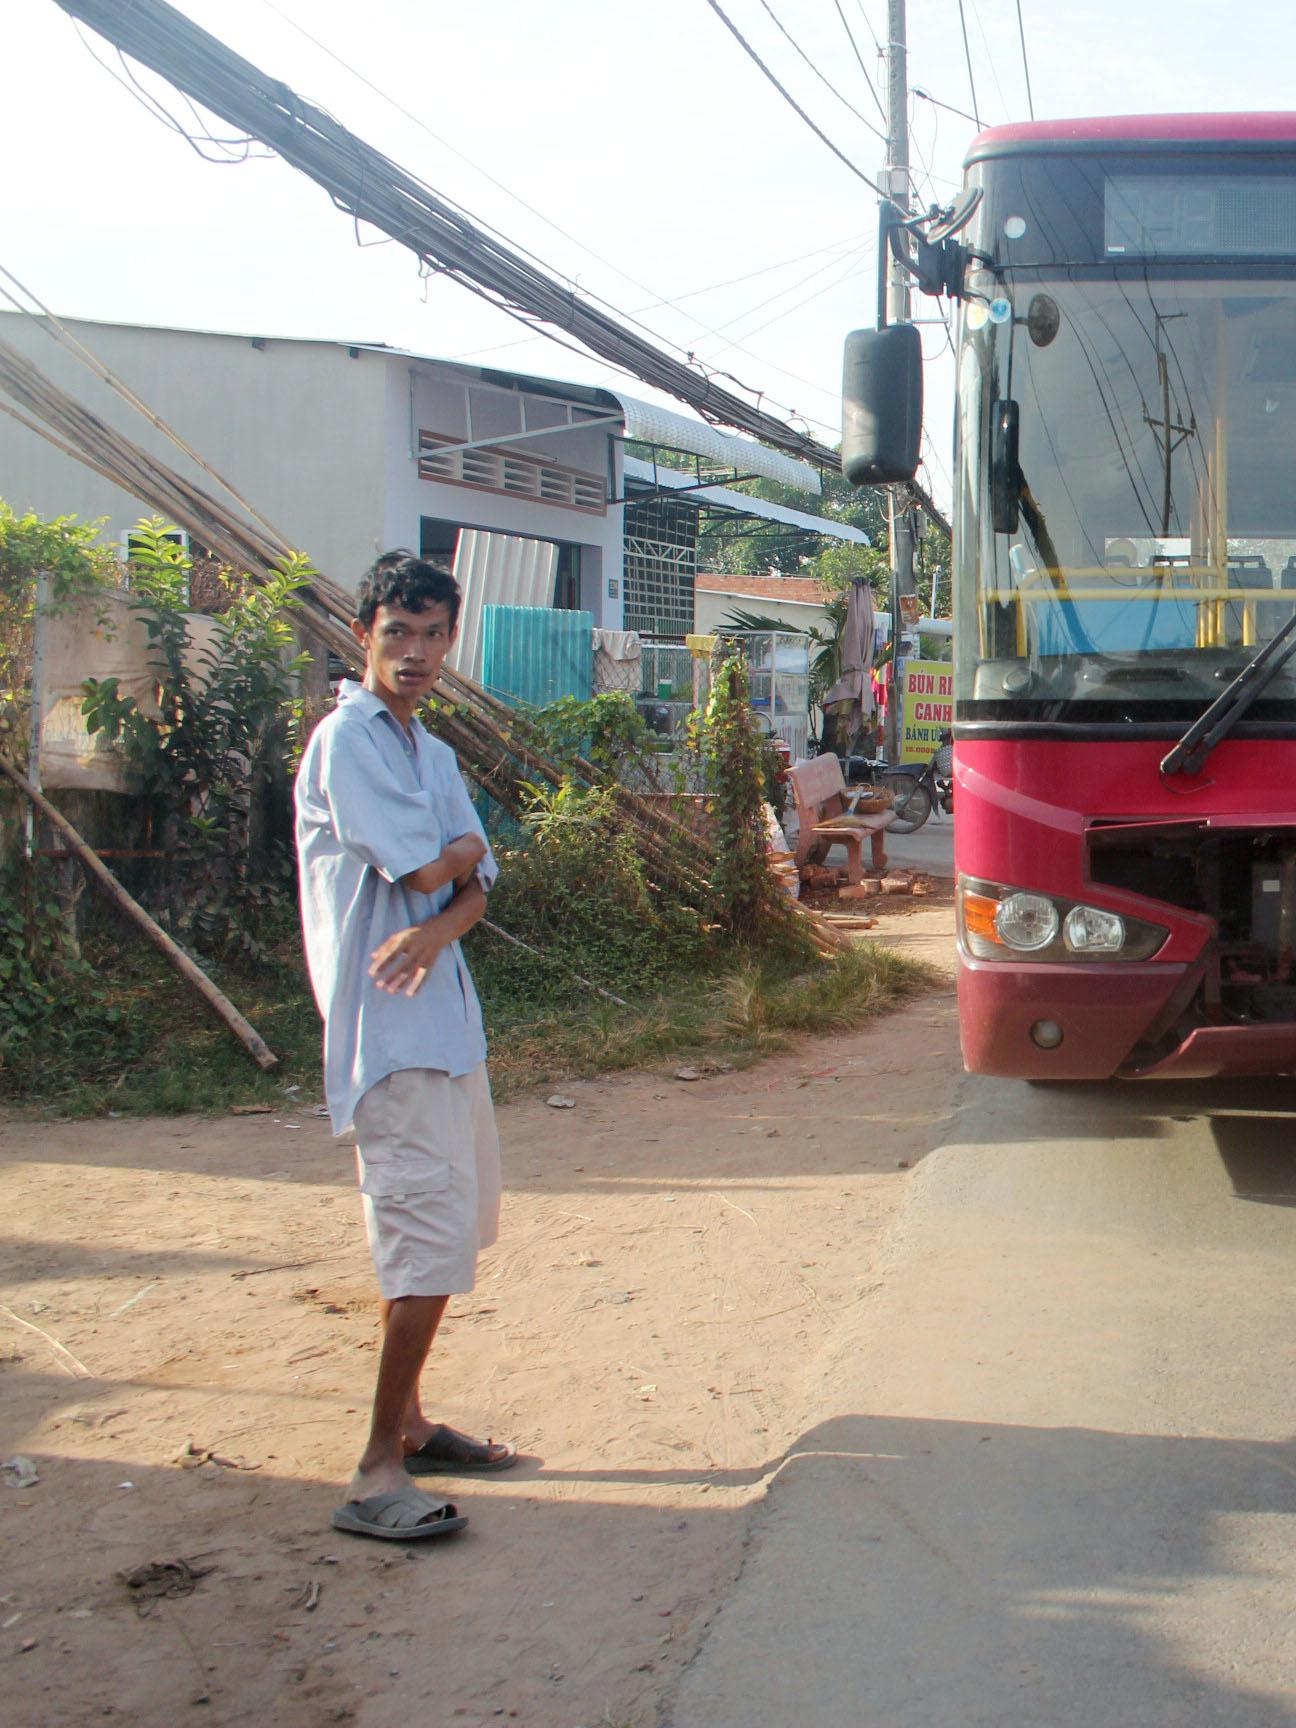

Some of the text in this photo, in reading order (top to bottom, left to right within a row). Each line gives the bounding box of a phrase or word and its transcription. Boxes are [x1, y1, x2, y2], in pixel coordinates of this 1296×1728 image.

[908, 668, 934, 694] BÚN
[915, 703, 952, 722] CANH
[906, 724, 929, 741] BÁNH
